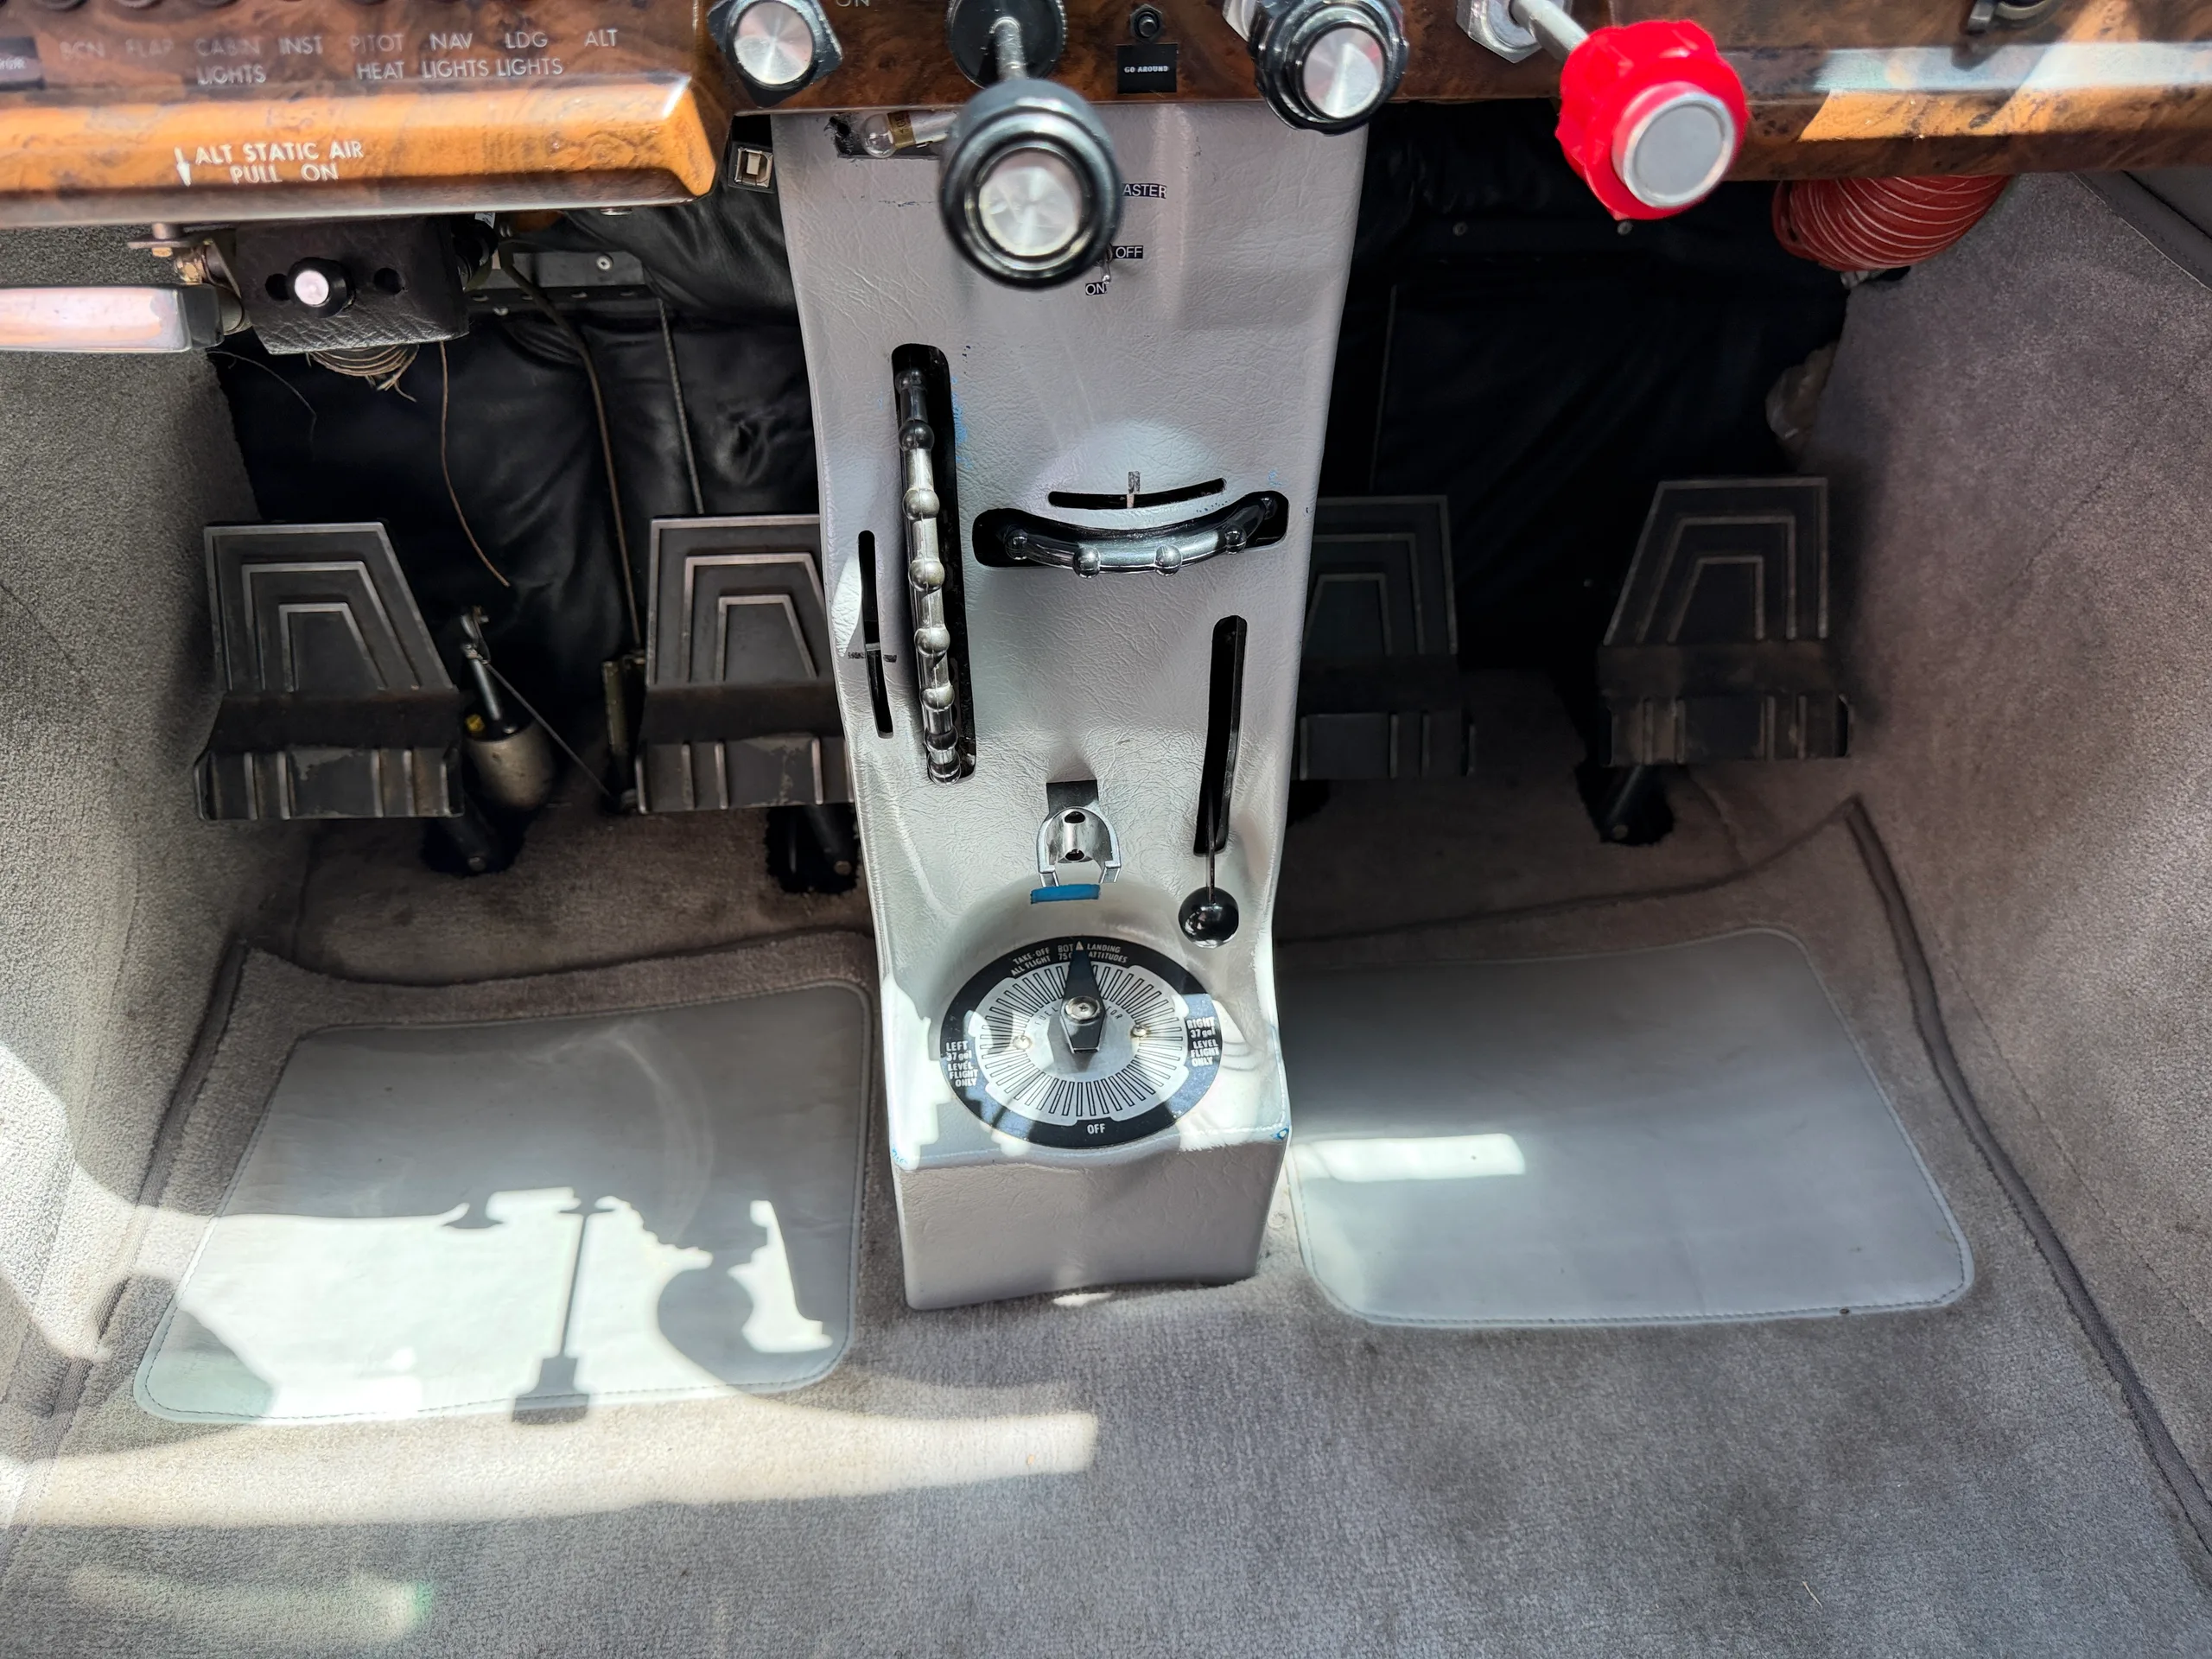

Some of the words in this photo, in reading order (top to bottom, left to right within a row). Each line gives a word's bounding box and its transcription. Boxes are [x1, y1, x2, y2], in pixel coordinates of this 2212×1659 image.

[125, 39, 173, 58] FLAP
[194, 37, 260, 56] CABIN
[278, 34, 323, 54] INST
[350, 33, 404, 53] PITOT
[429, 32, 473, 50] NAV
[505, 31, 549, 49] LDG
[584, 28, 618, 47] ALT
[357, 60, 405, 79] HEAT
[422, 60, 489, 79] LIGHTS
[495, 58, 563, 77] LIGHTS
[196, 63, 267, 86] LIGHTS
[195, 143, 232, 166] ALT
[243, 142, 319, 162] STATIC
[329, 140, 365, 160] AIR
[229, 164, 283, 185] PULL
[301, 162, 339, 181] ON
[1123, 184, 1166, 199] ASTER
[1116, 246, 1142, 258] OFF
[1085, 283, 1106, 295] ON
[1013, 947, 1050, 965] TAKE-OFF
[1058, 944, 1073, 953] BOT
[1087, 944, 1121, 953] LANDING
[1010, 965, 1024, 976] ALL
[1025, 955, 1051, 969] FLIGHT
[1089, 950, 1128, 963] ATTITUDES
[1186, 1016, 1215, 1029] RIGHT
[1190, 1029, 1201, 1039] 37
[946, 1040, 968, 1052] LEFT
[1192, 1039, 1218, 1049] LEVEL
[946, 1052, 957, 1061] 37
[1190, 1046, 1219, 1058] FLIGHT
[947, 1061, 973, 1071] LEVEL
[1192, 1056, 1213, 1067] ONLY
[949, 1069, 978, 1080] FLIGHT
[955, 1077, 976, 1087] ONLY
[1087, 1123, 1105, 1135] OFF
